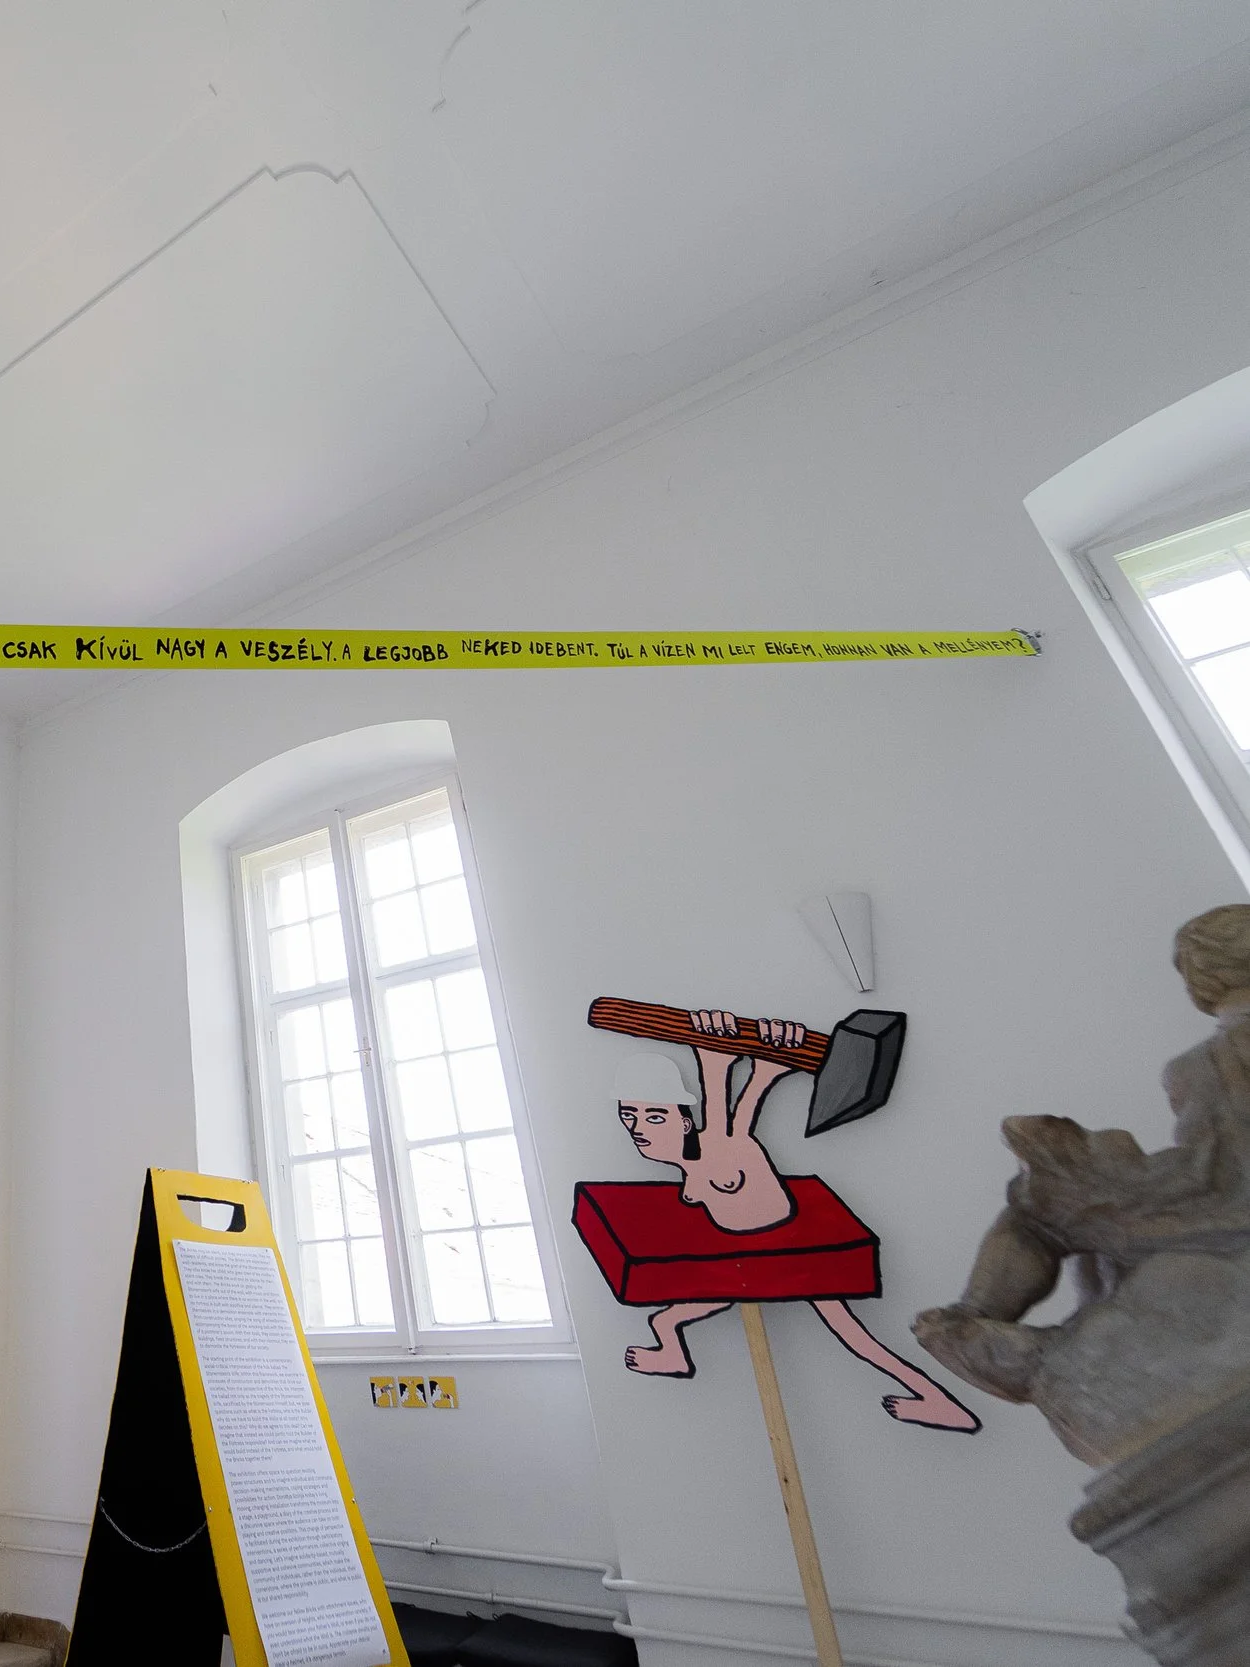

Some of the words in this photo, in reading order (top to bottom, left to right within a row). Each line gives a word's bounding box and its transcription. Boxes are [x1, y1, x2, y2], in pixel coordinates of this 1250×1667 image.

[1, 640, 57, 661] CSAK
[75, 635, 144, 662] KÍVÜL
[156, 637, 206, 661] NAGY
[214, 640, 228, 659] A
[239, 637, 337, 663] VESZÉLY.
[341, 643, 352, 660] A
[362, 643, 449, 663] LEGJOBB
[461, 638, 523, 657] NEKED
[528, 640, 599, 658] IDEBENT.
[606, 642, 634, 660] TÚL
[639, 644, 649, 659] A
[651, 639, 696, 659] VÍZEN
[701, 644, 725, 660] MI
[727, 643, 756, 657] LELT
[764, 641, 823, 659] ENGEM,
[822, 643, 878, 657] HONNAN
[879, 643, 915, 657] VAN
[917, 643, 932, 656] A
[934, 637, 1026, 654] MELLÉNYEM?
